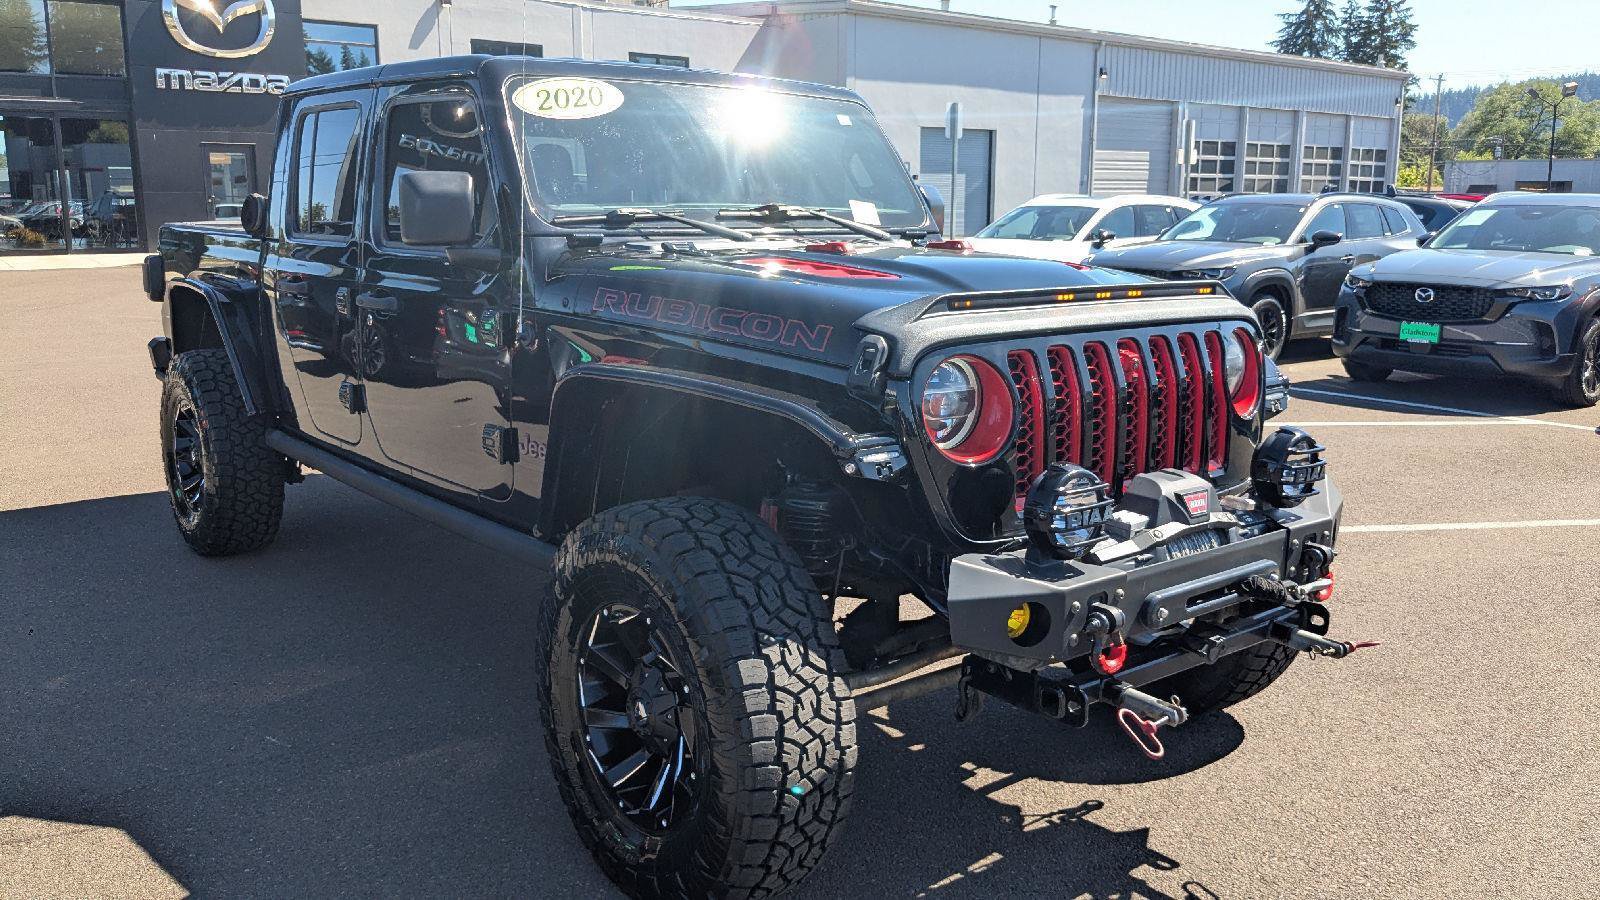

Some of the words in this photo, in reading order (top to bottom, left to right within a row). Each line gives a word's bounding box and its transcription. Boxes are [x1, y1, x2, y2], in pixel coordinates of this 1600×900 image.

[536, 86, 603, 111] 2020
[592, 287, 833, 352] RUBICON
[1401, 328, 1438, 337] Gladstone
[519, 432, 547, 459] Jee
[1066, 504, 1115, 528] PIAA
